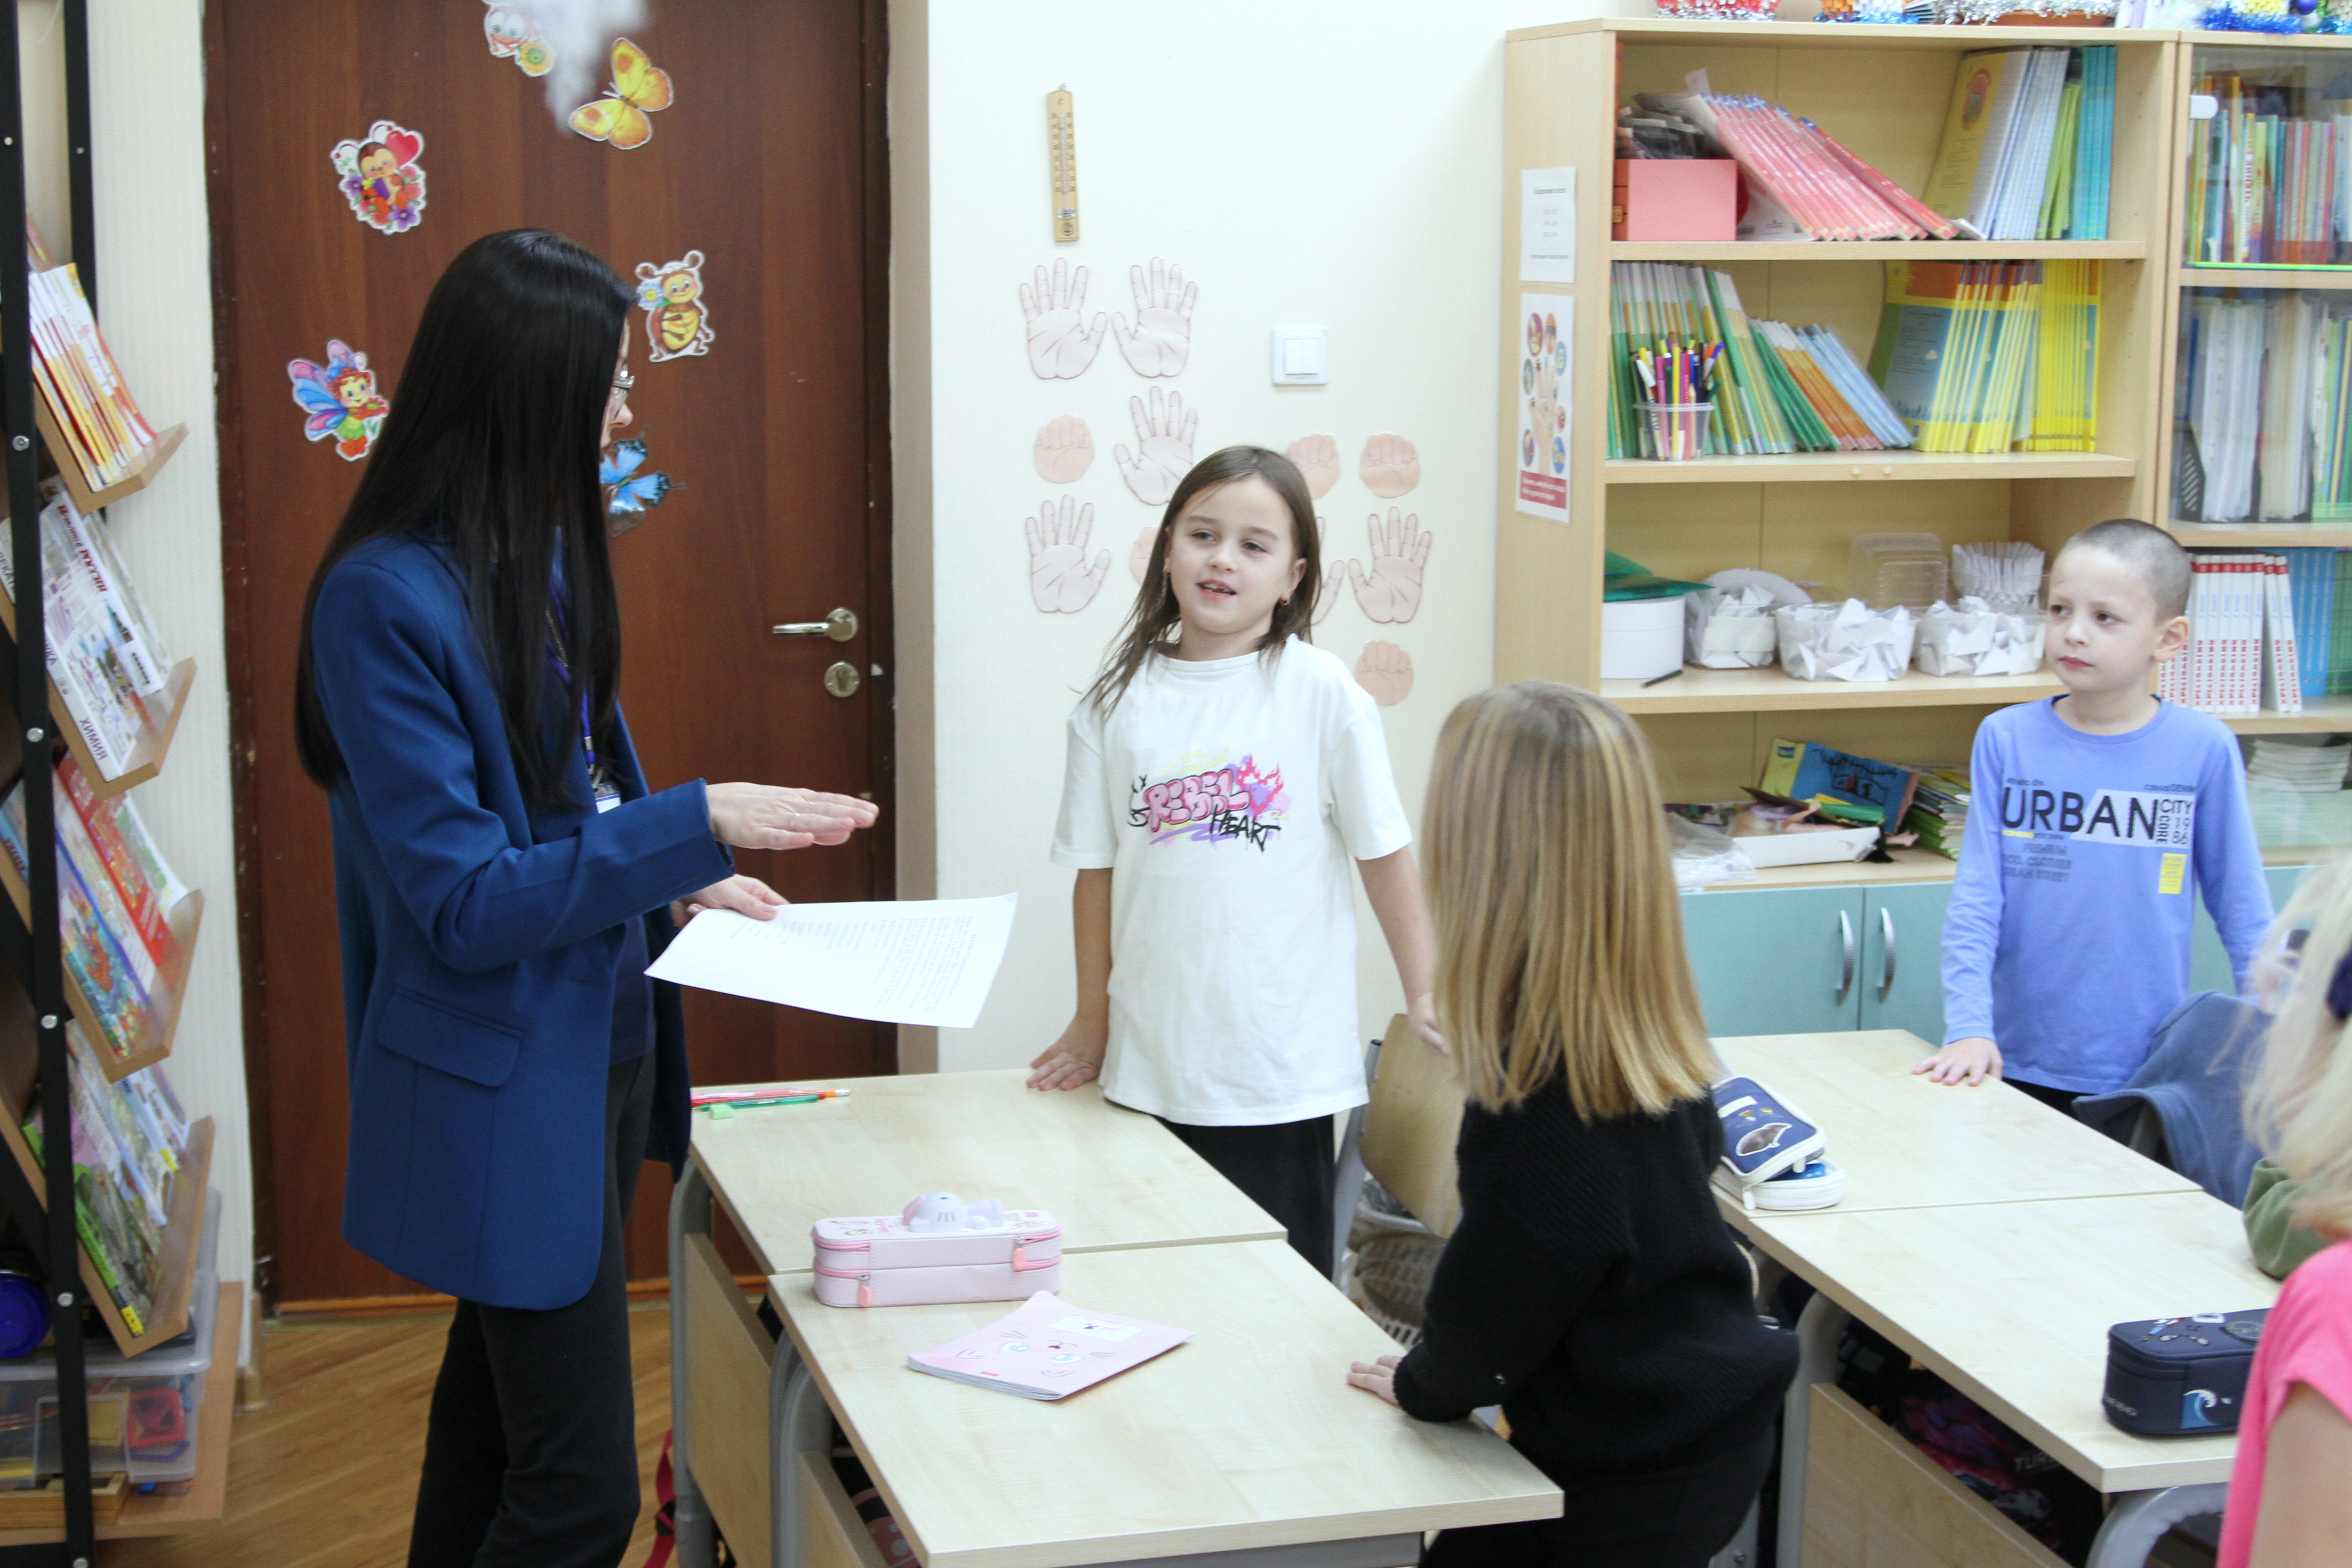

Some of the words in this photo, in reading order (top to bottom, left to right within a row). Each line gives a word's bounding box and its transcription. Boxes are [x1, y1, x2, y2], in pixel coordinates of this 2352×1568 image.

[80, 549, 108, 592] РОССИИ
[79, 718, 107, 760] ХИМИЯ
[1144, 769, 1251, 833] REBEL
[2002, 787, 2158, 840] URBAN
[2161, 799, 2192, 814] CITY
[1209, 804, 1281, 852] HEART
[2156, 815, 2170, 843] CORE
